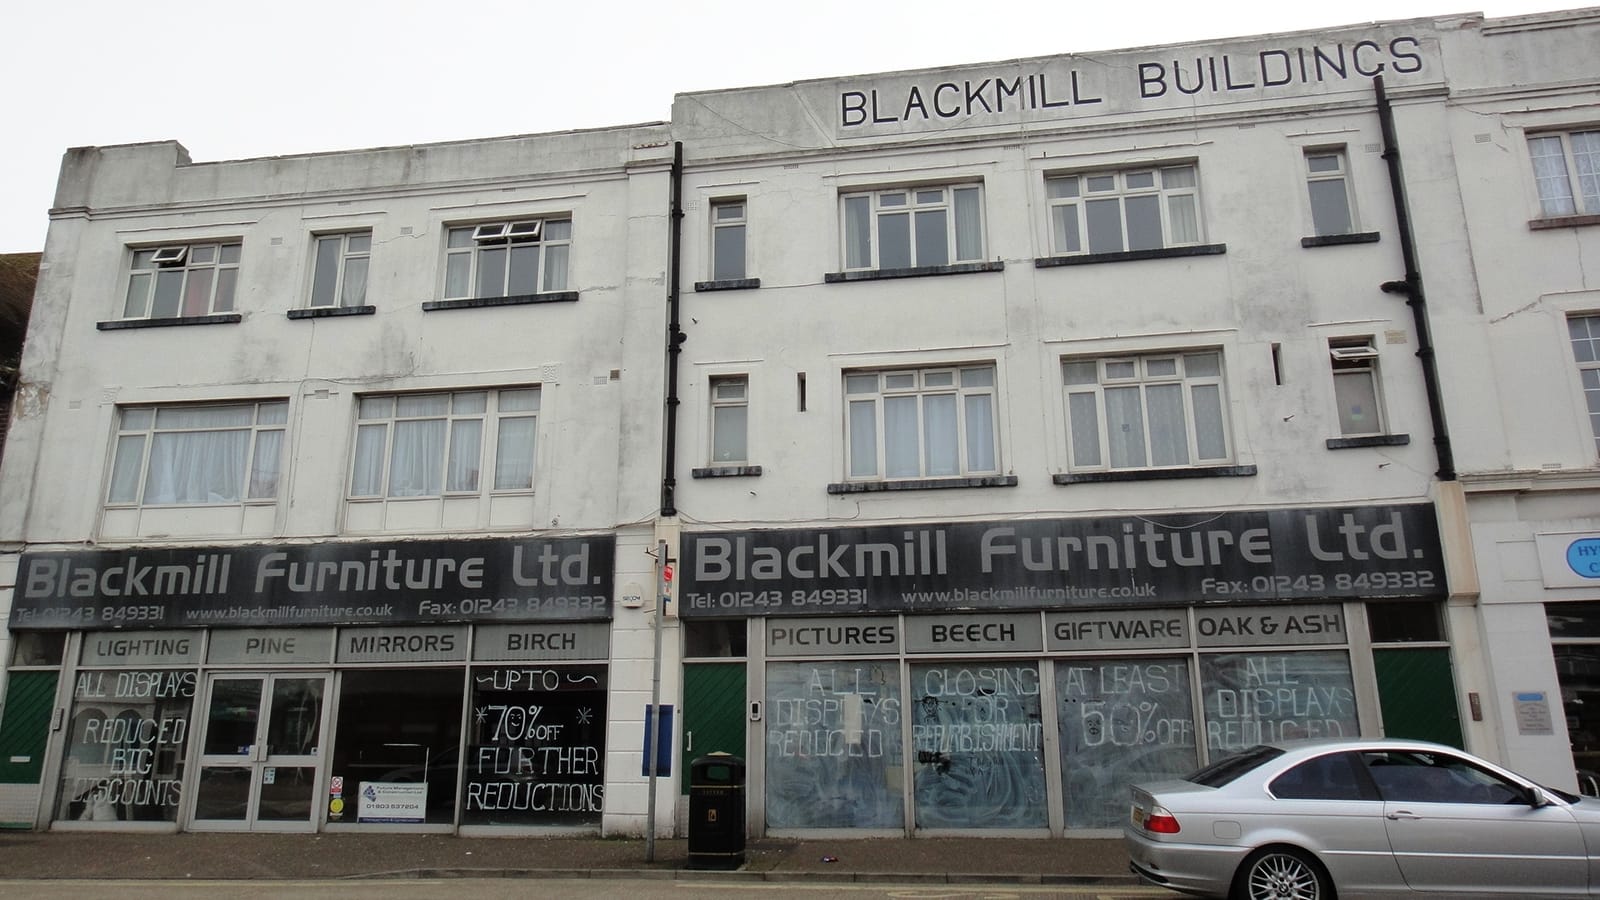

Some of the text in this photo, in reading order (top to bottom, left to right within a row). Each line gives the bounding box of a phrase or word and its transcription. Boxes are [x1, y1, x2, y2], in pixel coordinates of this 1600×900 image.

[841, 36, 1423, 127] BLACKMILL BUILDINGS
[694, 511, 1424, 582] Blackmill Furniture Ltd.
[1578, 545, 1600, 557] HY
[24, 543, 600, 598] Blackmill Furniture Ltd.
[1200, 570, 1436, 595] Fax: 01243 849332
[418, 599, 457, 616] Fax:
[460, 598, 518, 615] 01243
[525, 595, 606, 613] 849332
[686, 588, 868, 609] Tel: 01243 849331
[901, 582, 1157, 604] www.blackmillfurniture.co.uk
[101, 606, 165, 621] 849331
[186, 603, 393, 620] www.blackmillfurniture.co.uk
[772, 625, 895, 646] PICTURES
[931, 623, 1016, 643] BEECH
[1054, 619, 1182, 641] GIFTWARE
[1198, 614, 1341, 637] OAK & ASH
[97, 639, 190, 657] LIGHTING
[245, 637, 296, 655] PINE
[350, 634, 455, 653] MIRRORS
[507, 632, 577, 651] BIRCH
[74, 671, 198, 698] ALL DISPLAYS
[810, 668, 877, 697] ALL
[924, 667, 1040, 697] CLOSING
[1065, 664, 1185, 696] AT LEAST
[1245, 656, 1300, 688] ALL
[961, 696, 1009, 723] FOR
[82, 718, 187, 744] REDUCED
[769, 729, 883, 758] REDUCED
[110, 748, 153, 775] BIG
[478, 746, 598, 775] FURTHER
[466, 781, 605, 812] REDUCTIONS
